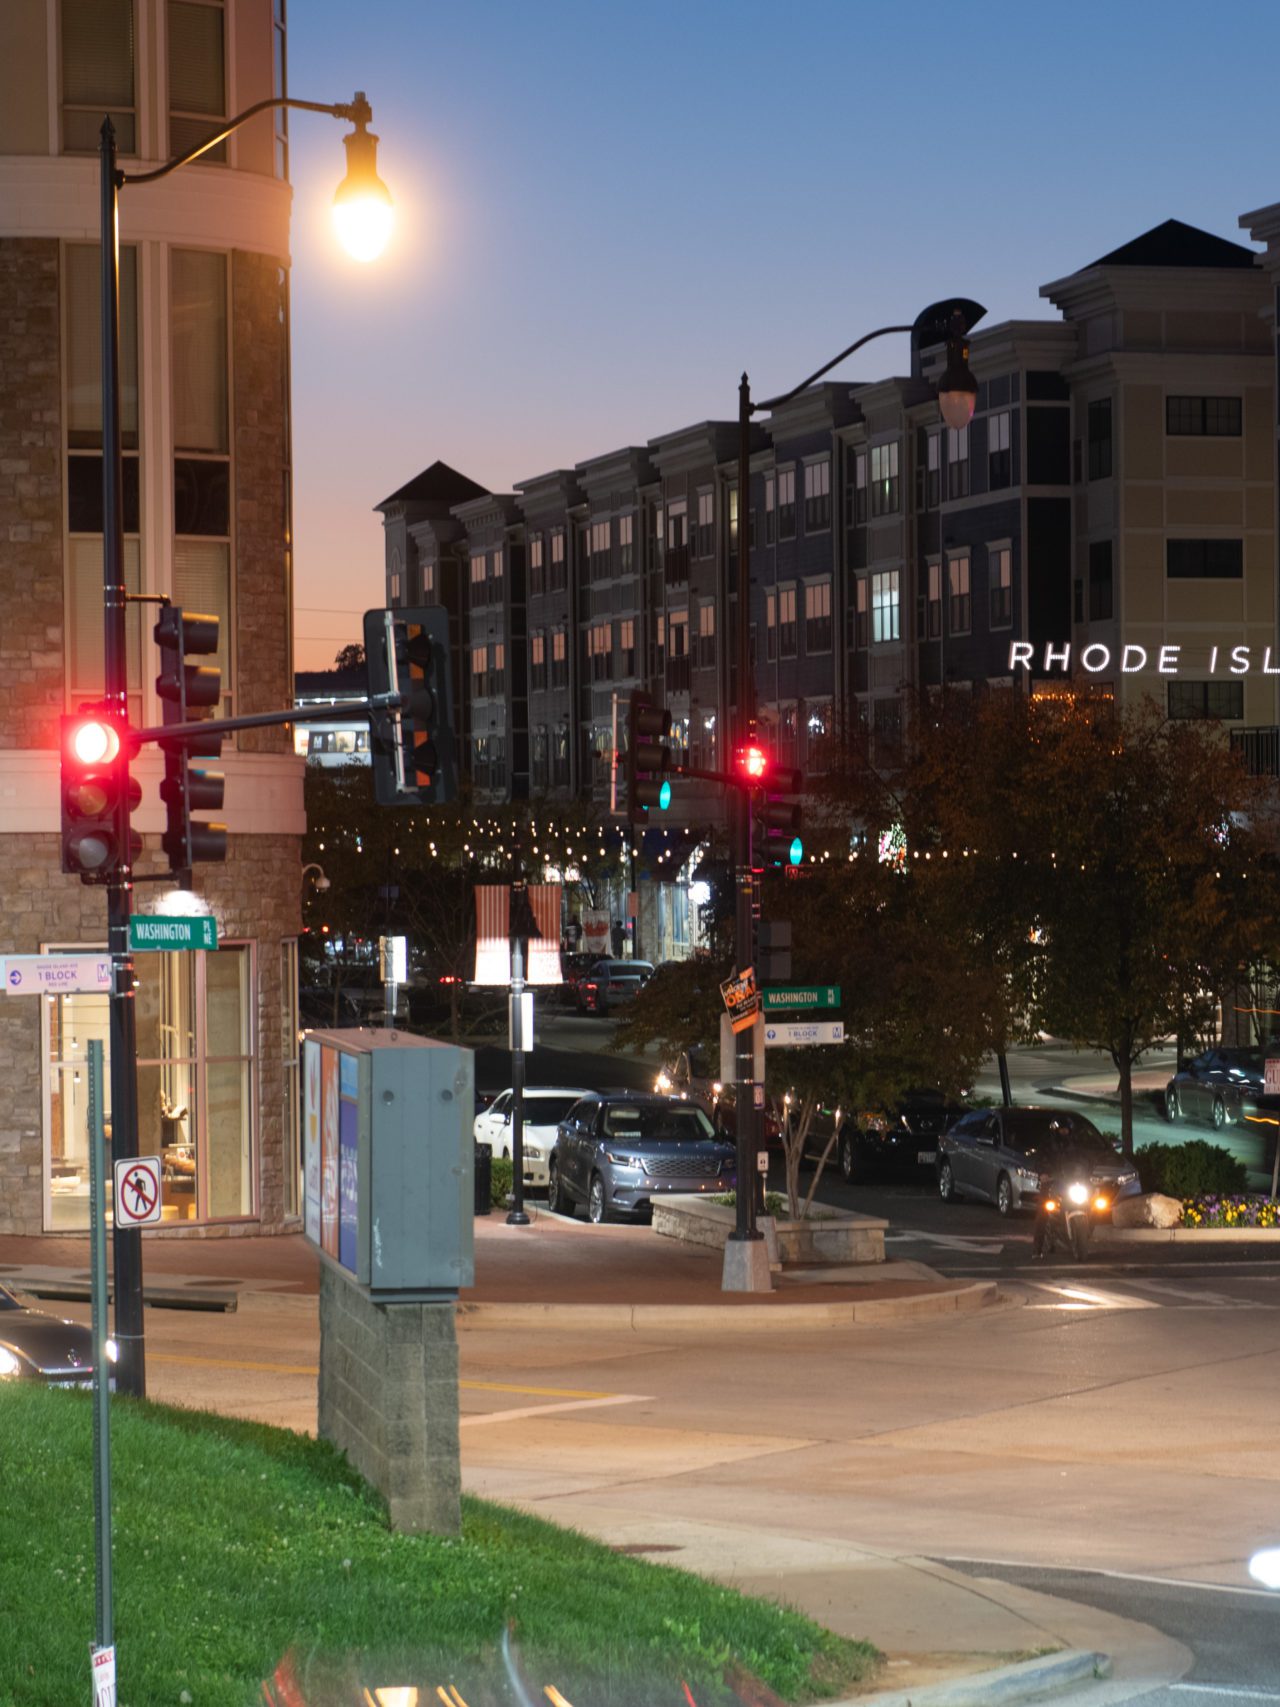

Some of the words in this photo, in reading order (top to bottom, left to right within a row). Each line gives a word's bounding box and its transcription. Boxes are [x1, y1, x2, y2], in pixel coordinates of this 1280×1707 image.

[1009, 641, 1181, 673] RHODE
[135, 923, 191, 941] WASHINGTON
[203, 920, 211, 932] PL
[203, 933, 212, 945] NE
[45, 970, 77, 981] BLOCK
[768, 992, 818, 1004] WASHINGTON
